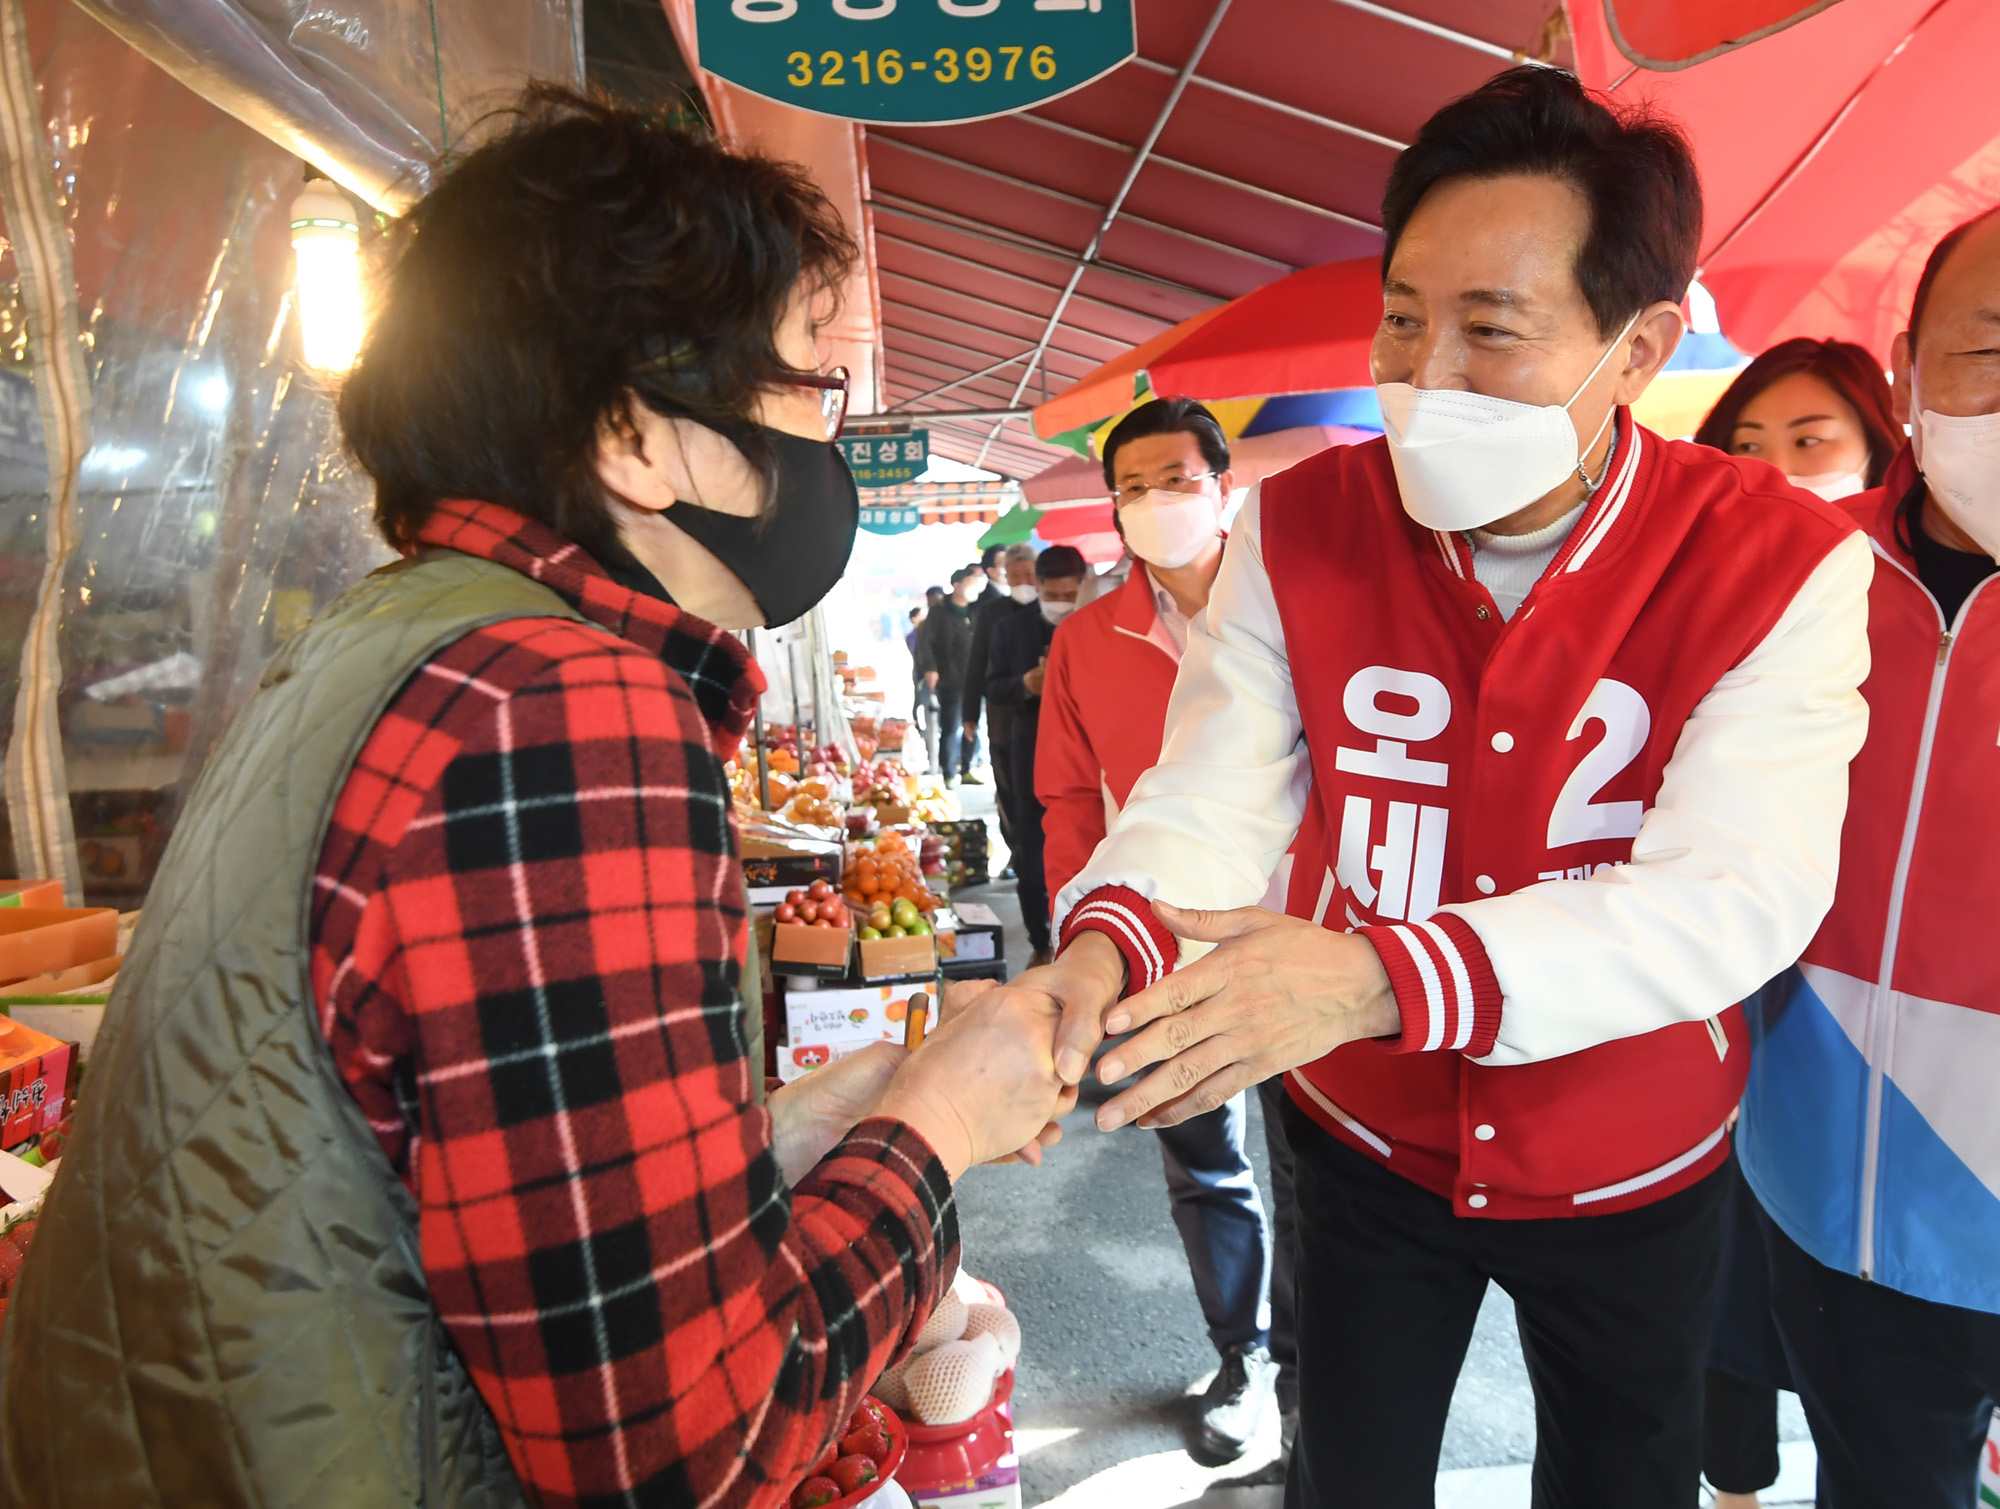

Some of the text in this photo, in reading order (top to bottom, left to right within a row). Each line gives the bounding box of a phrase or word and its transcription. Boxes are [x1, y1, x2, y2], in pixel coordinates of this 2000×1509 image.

[786, 44, 1058, 88] 3216-3976
[1334, 664, 1453, 931] 오세
[1546, 678, 1652, 850] 2
